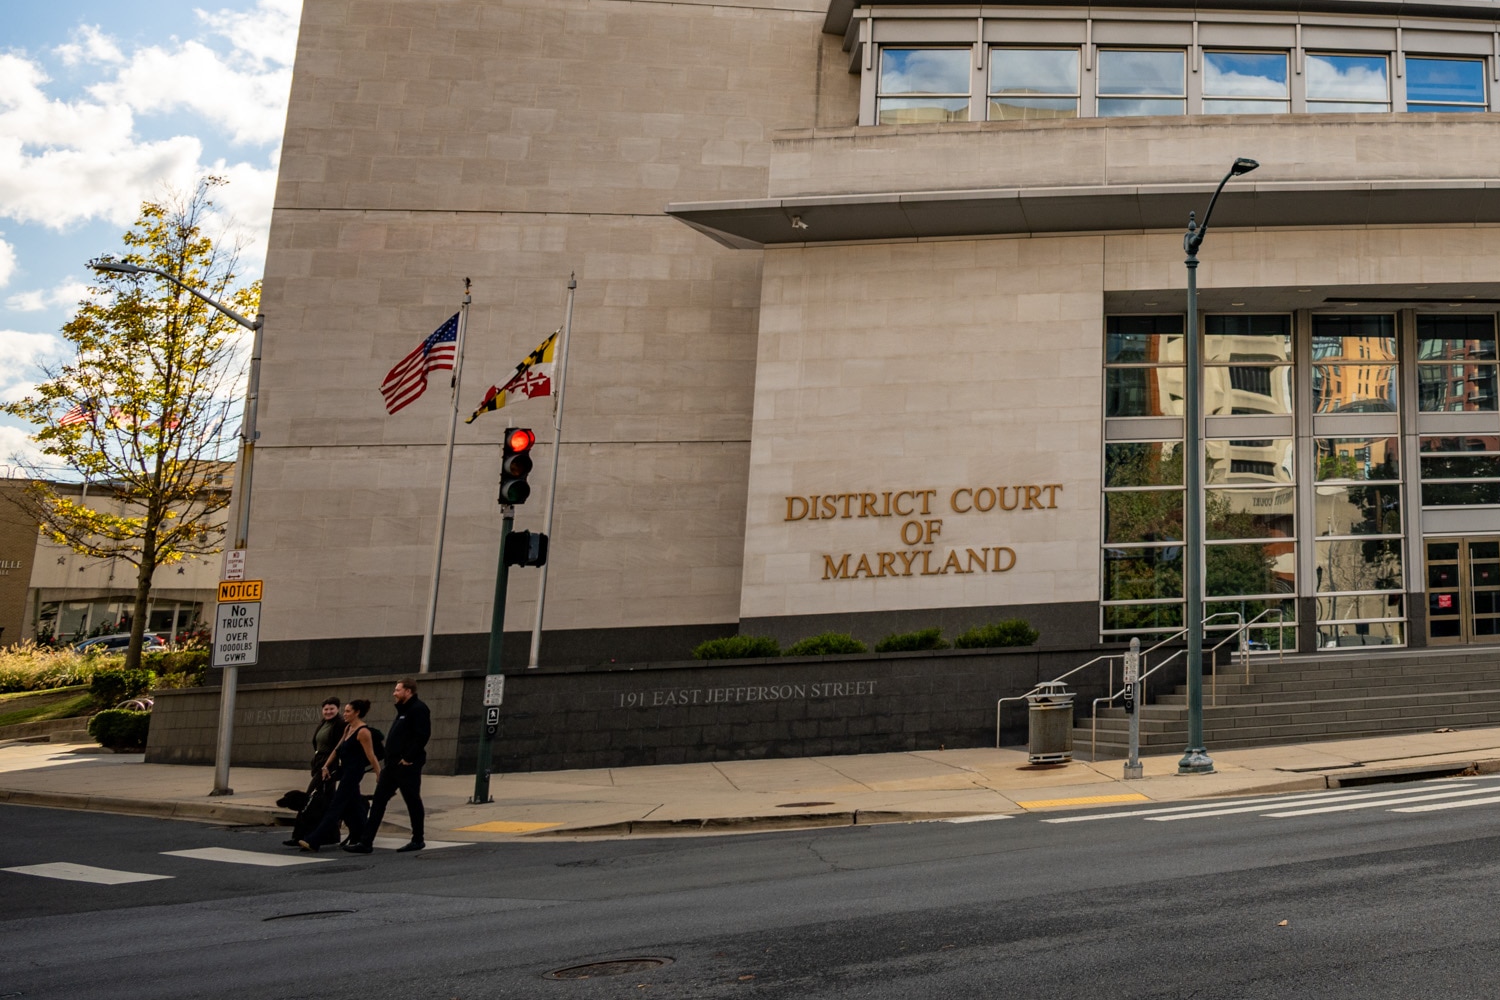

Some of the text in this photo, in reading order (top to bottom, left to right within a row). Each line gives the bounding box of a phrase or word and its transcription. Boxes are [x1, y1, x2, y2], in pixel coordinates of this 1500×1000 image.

[784, 483, 1064, 521] DISTRICT COURT
[901, 519, 943, 546] OF
[821, 546, 1017, 580] MARYLAND
[221, 584, 259, 598] NOTICE
[222, 617, 254, 628] TRUCKS
[226, 632, 248, 642] OVER
[224, 653, 246, 662] GVWR
[620, 681, 877, 707] 191 EAST JEFFERSON STREET
